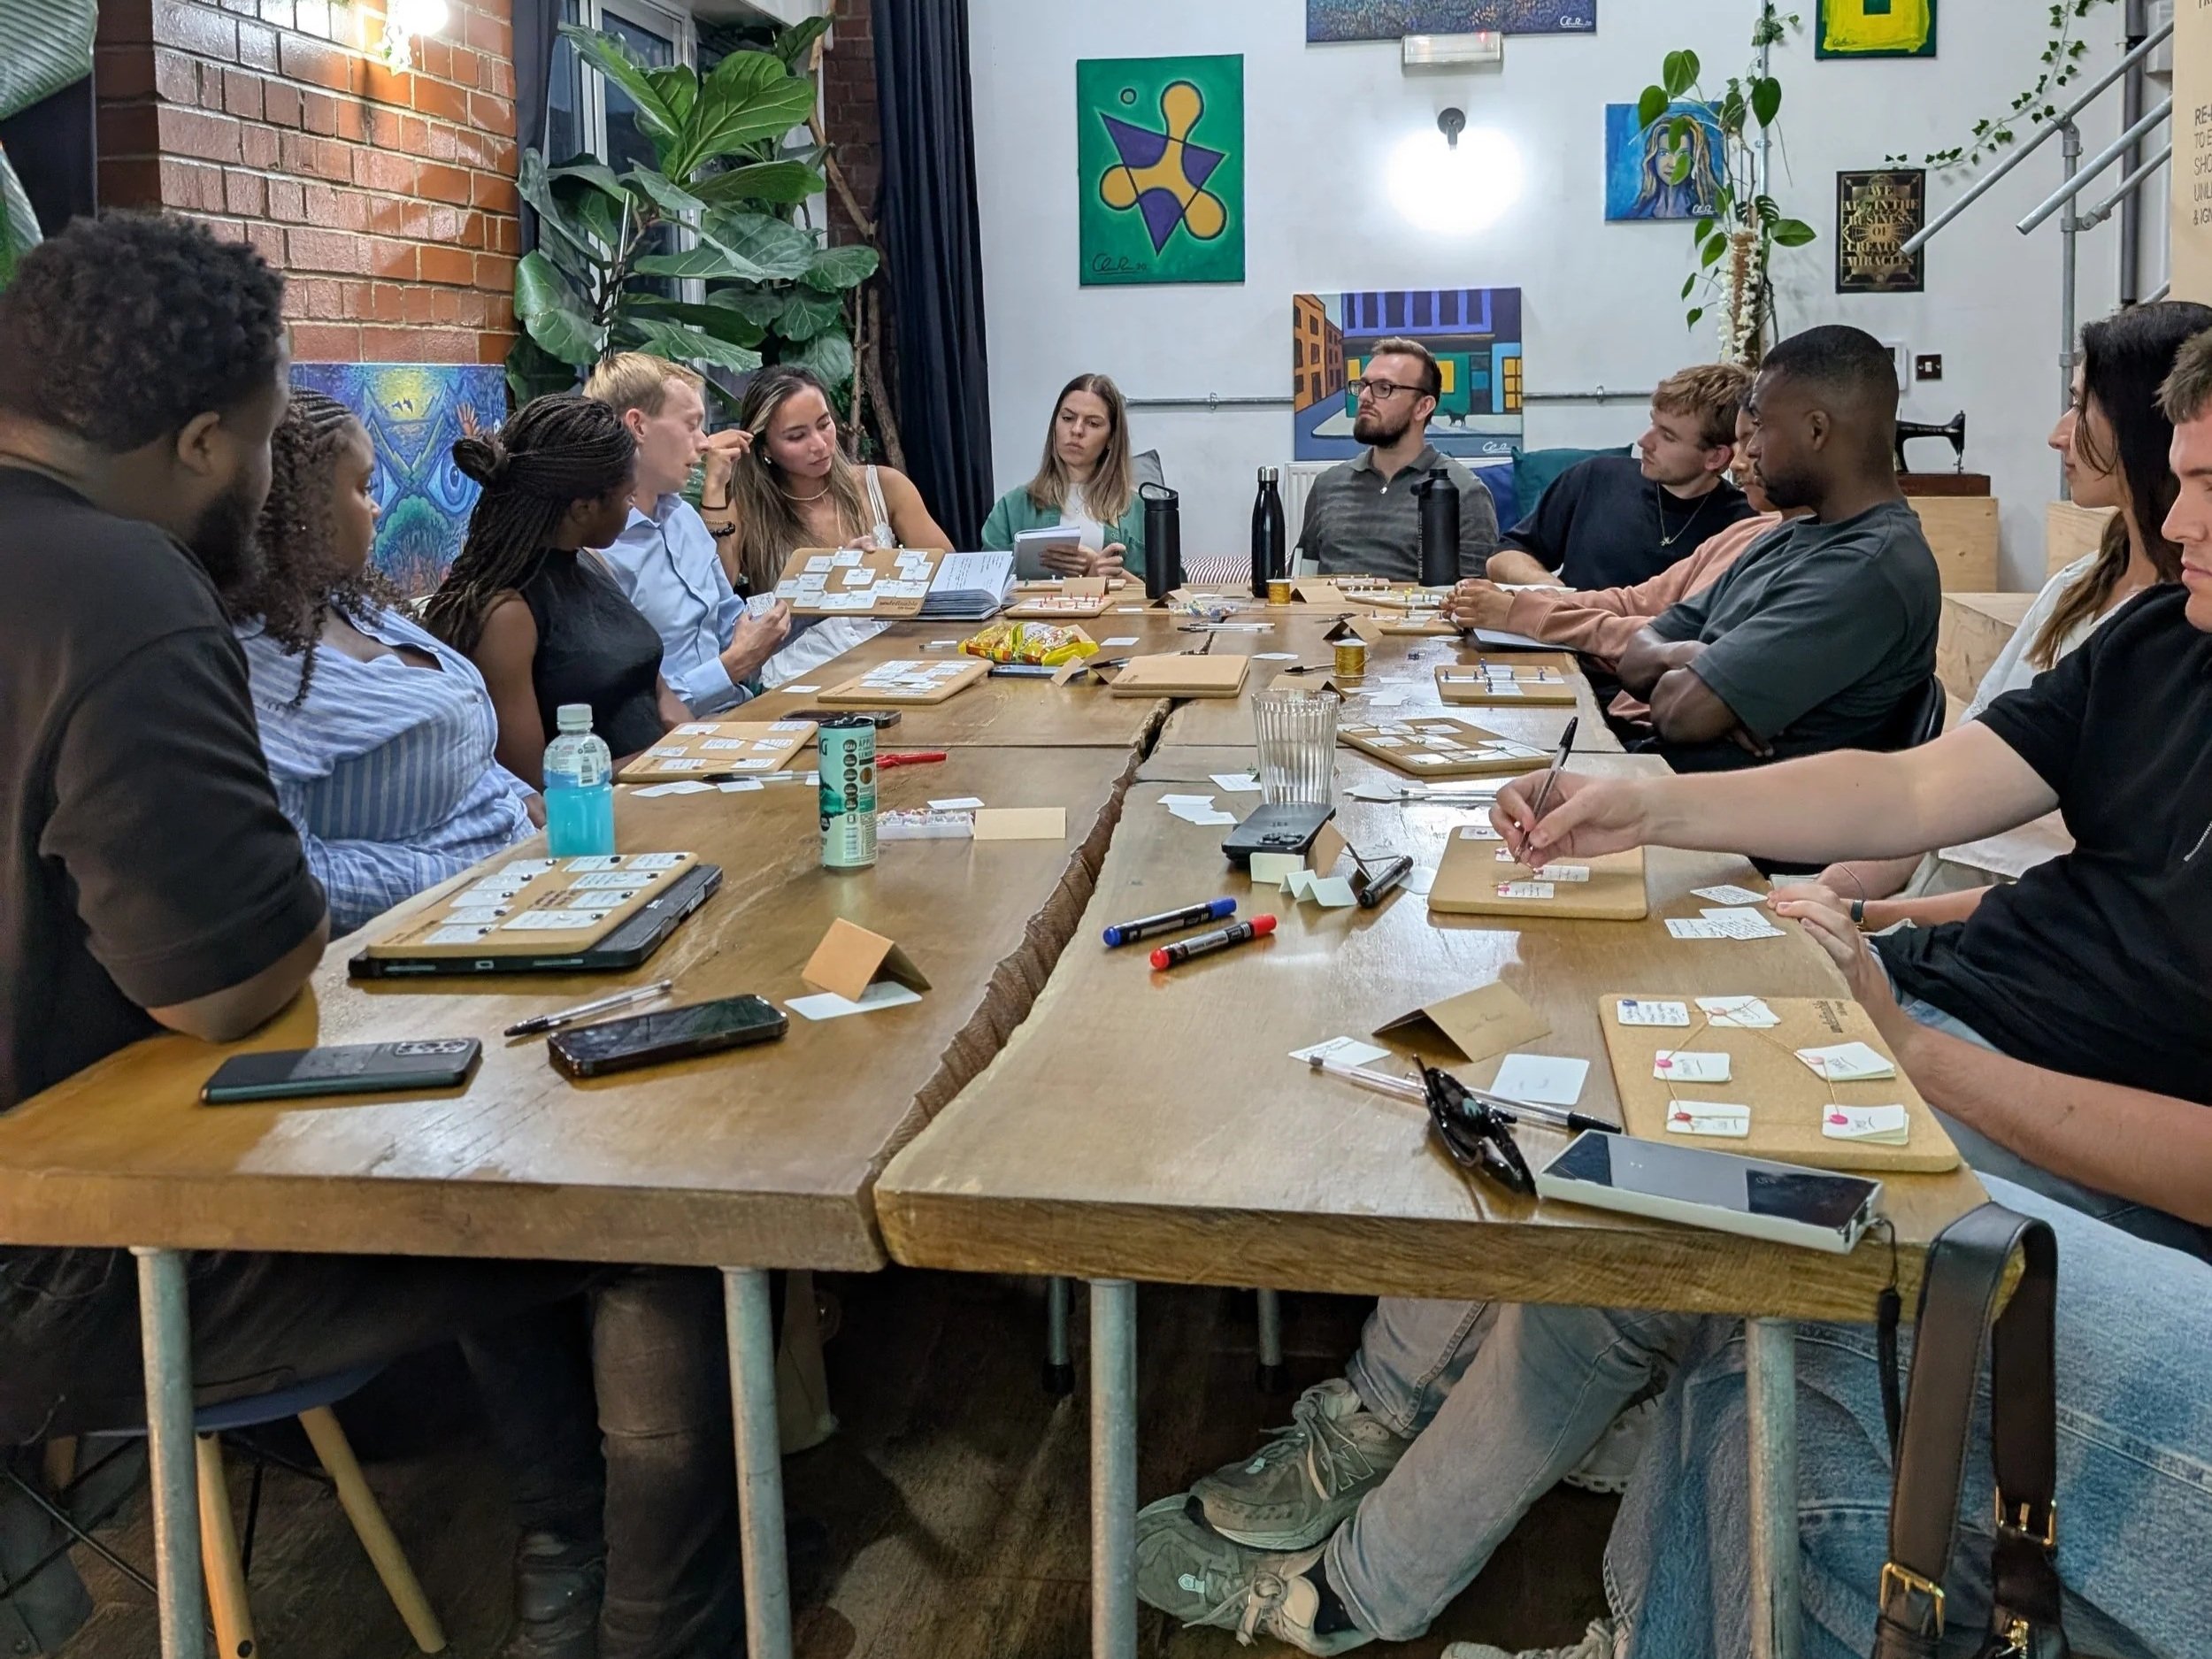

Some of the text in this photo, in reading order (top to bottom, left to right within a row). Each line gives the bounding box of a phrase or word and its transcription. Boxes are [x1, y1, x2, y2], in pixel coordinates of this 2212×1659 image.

[2194, 131, 2205, 149] TO
[1870, 185, 1893, 196] WE
[1874, 200, 1888, 210] IN
[1892, 199, 1918, 210] THE
[1848, 215, 1913, 226] BUSINESS
[1871, 226, 1886, 236] OF
[1847, 257, 1915, 266] MIRACLES
